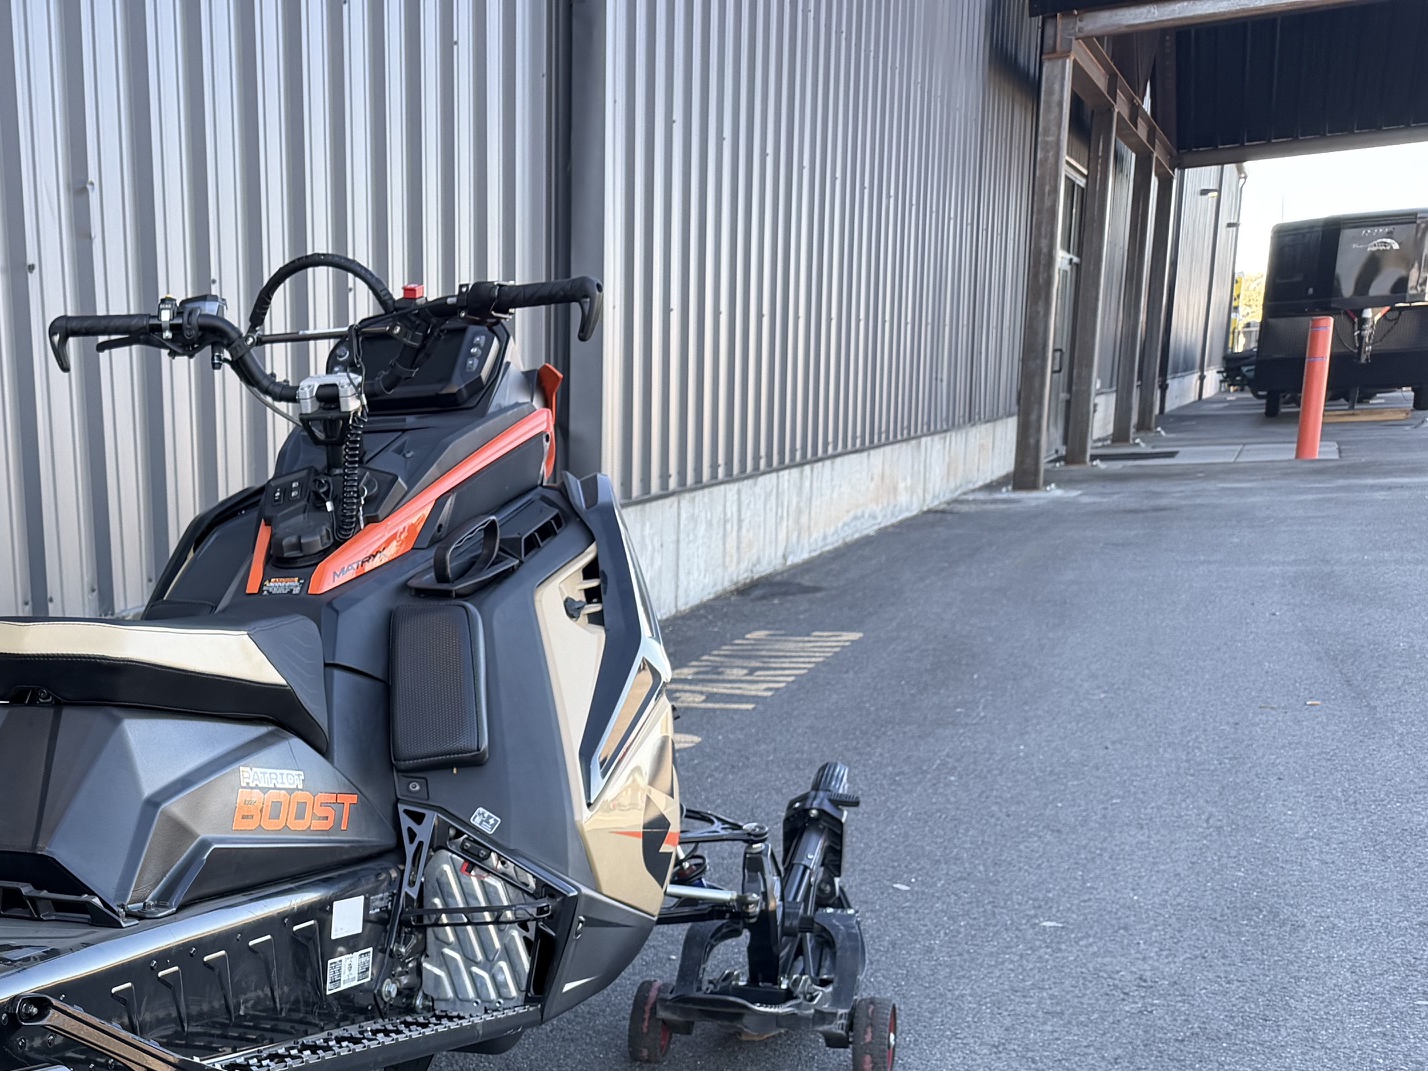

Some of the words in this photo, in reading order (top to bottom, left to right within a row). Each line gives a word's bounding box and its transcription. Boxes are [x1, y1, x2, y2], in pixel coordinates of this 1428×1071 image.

[332, 547, 390, 583] MATRYX
[239, 766, 305, 789] PATRIOT
[232, 788, 359, 832] BOOST
